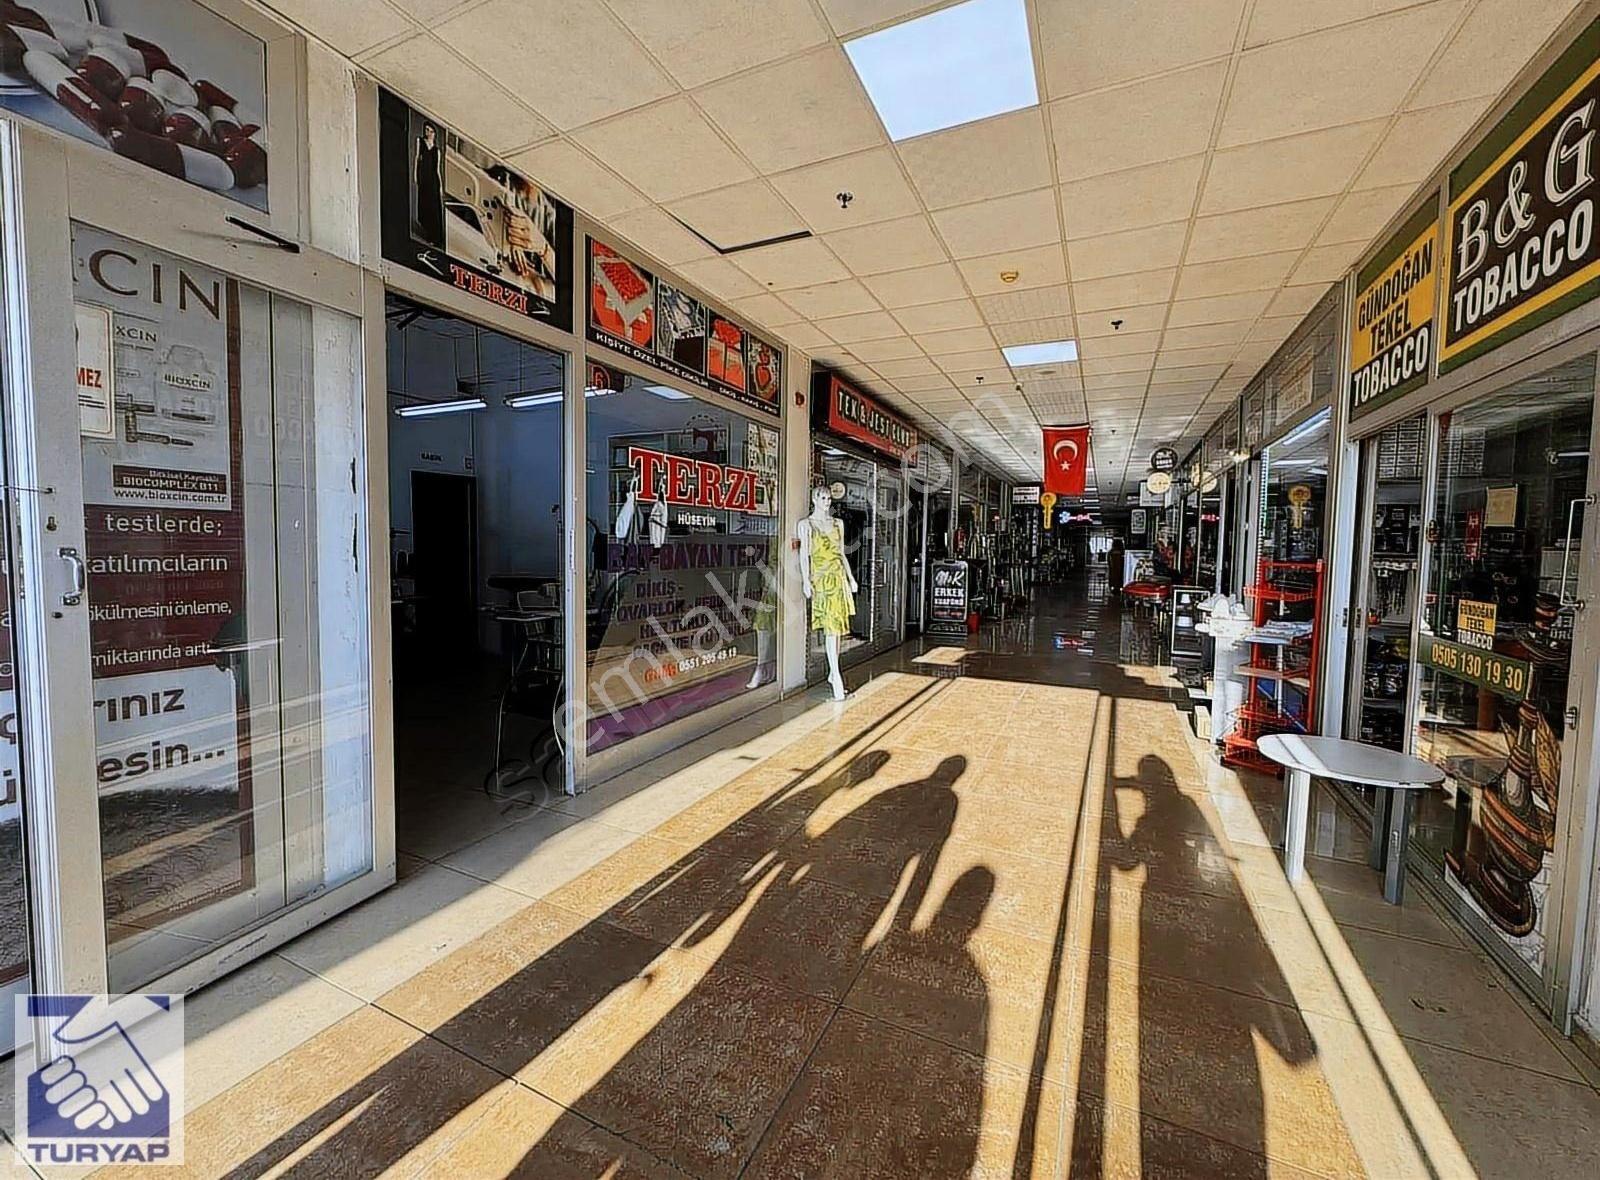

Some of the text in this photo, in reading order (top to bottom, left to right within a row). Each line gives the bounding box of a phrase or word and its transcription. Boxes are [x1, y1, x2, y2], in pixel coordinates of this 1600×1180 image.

[72, 247, 221, 321] CIN
[1359, 238, 1433, 332] GÜNDOĞAN
[1454, 199, 1593, 332] TOBACCO
[1370, 298, 1411, 357] TEKEL
[1354, 327, 1429, 407] TOBACCO
[122, 476, 197, 491] BIOCOMPLEX
[105, 513, 223, 536] testlerde;
[175, 601, 232, 616] önleme,
[1457, 629, 1493, 650] TOBACCO
[1432, 643, 1523, 692] 0505 130 19 30
